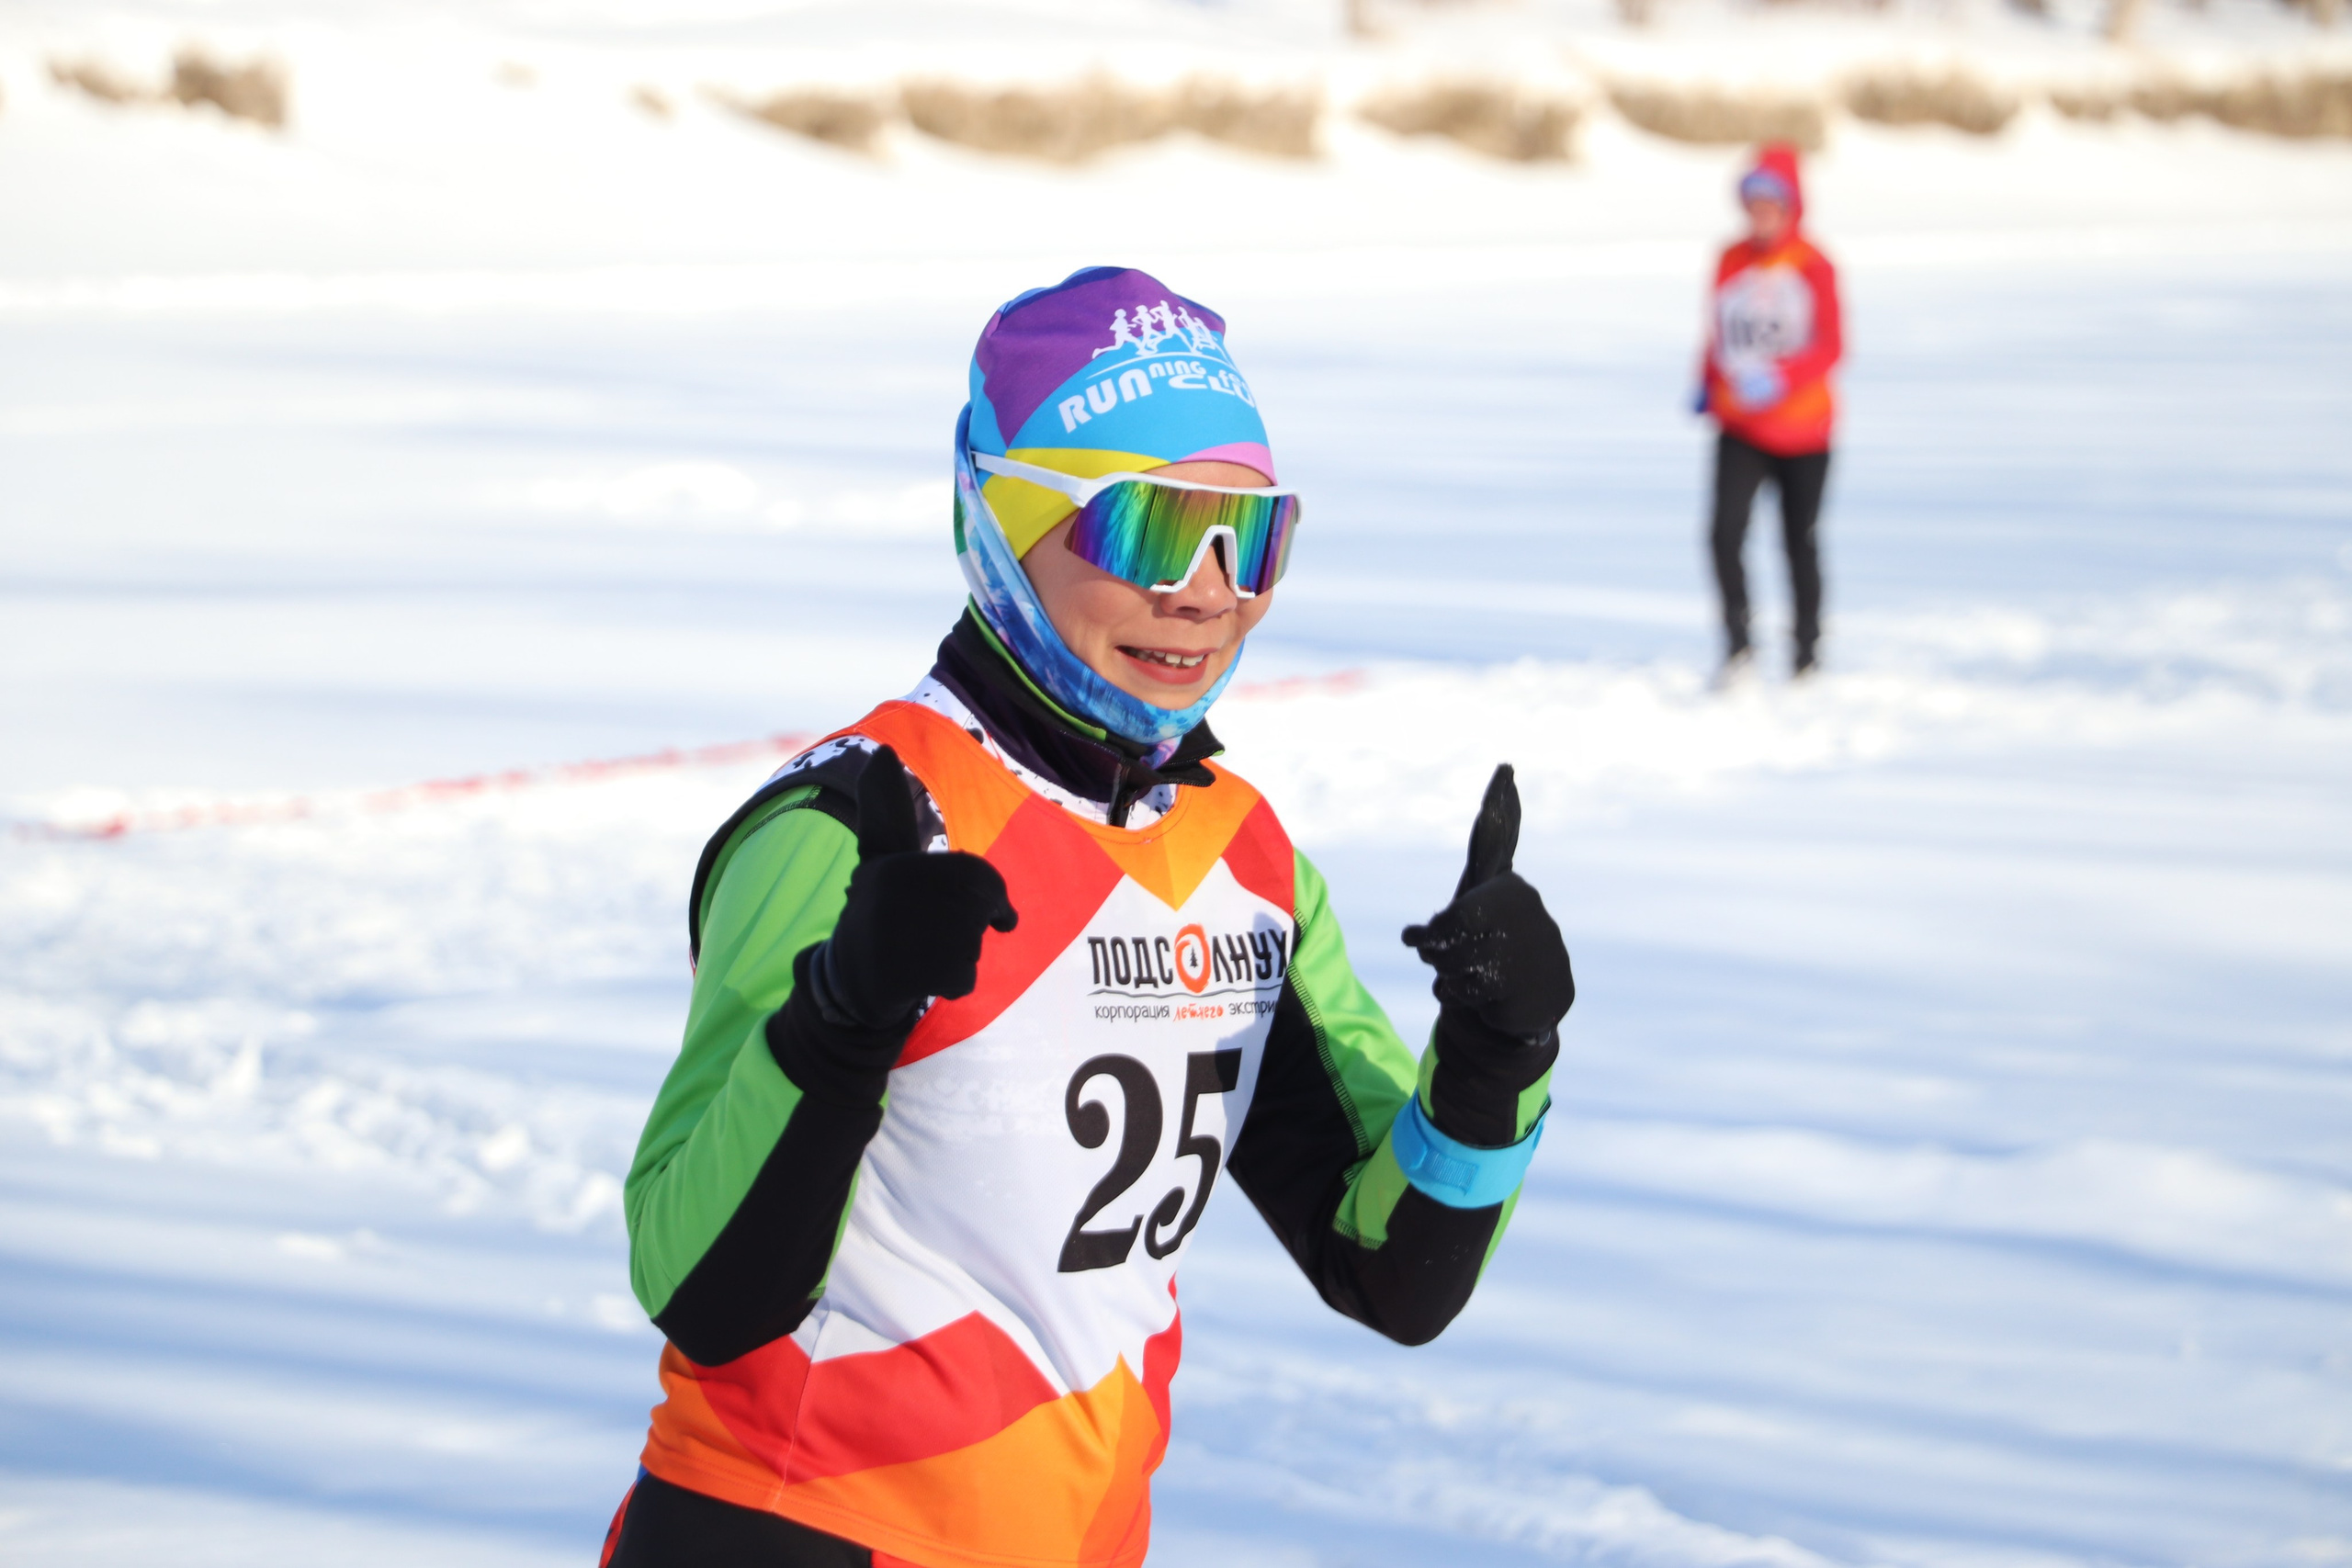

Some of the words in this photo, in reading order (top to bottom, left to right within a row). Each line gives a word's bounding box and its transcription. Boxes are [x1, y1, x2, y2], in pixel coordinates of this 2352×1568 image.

[1168, 373, 1255, 408] CLU
[1087, 922, 1287, 994] ПОДСОЛНУХ
[1094, 1003, 1170, 1023] корпорация
[1228, 1000, 1277, 1019] экстри
[1057, 1046, 1243, 1273] 25
